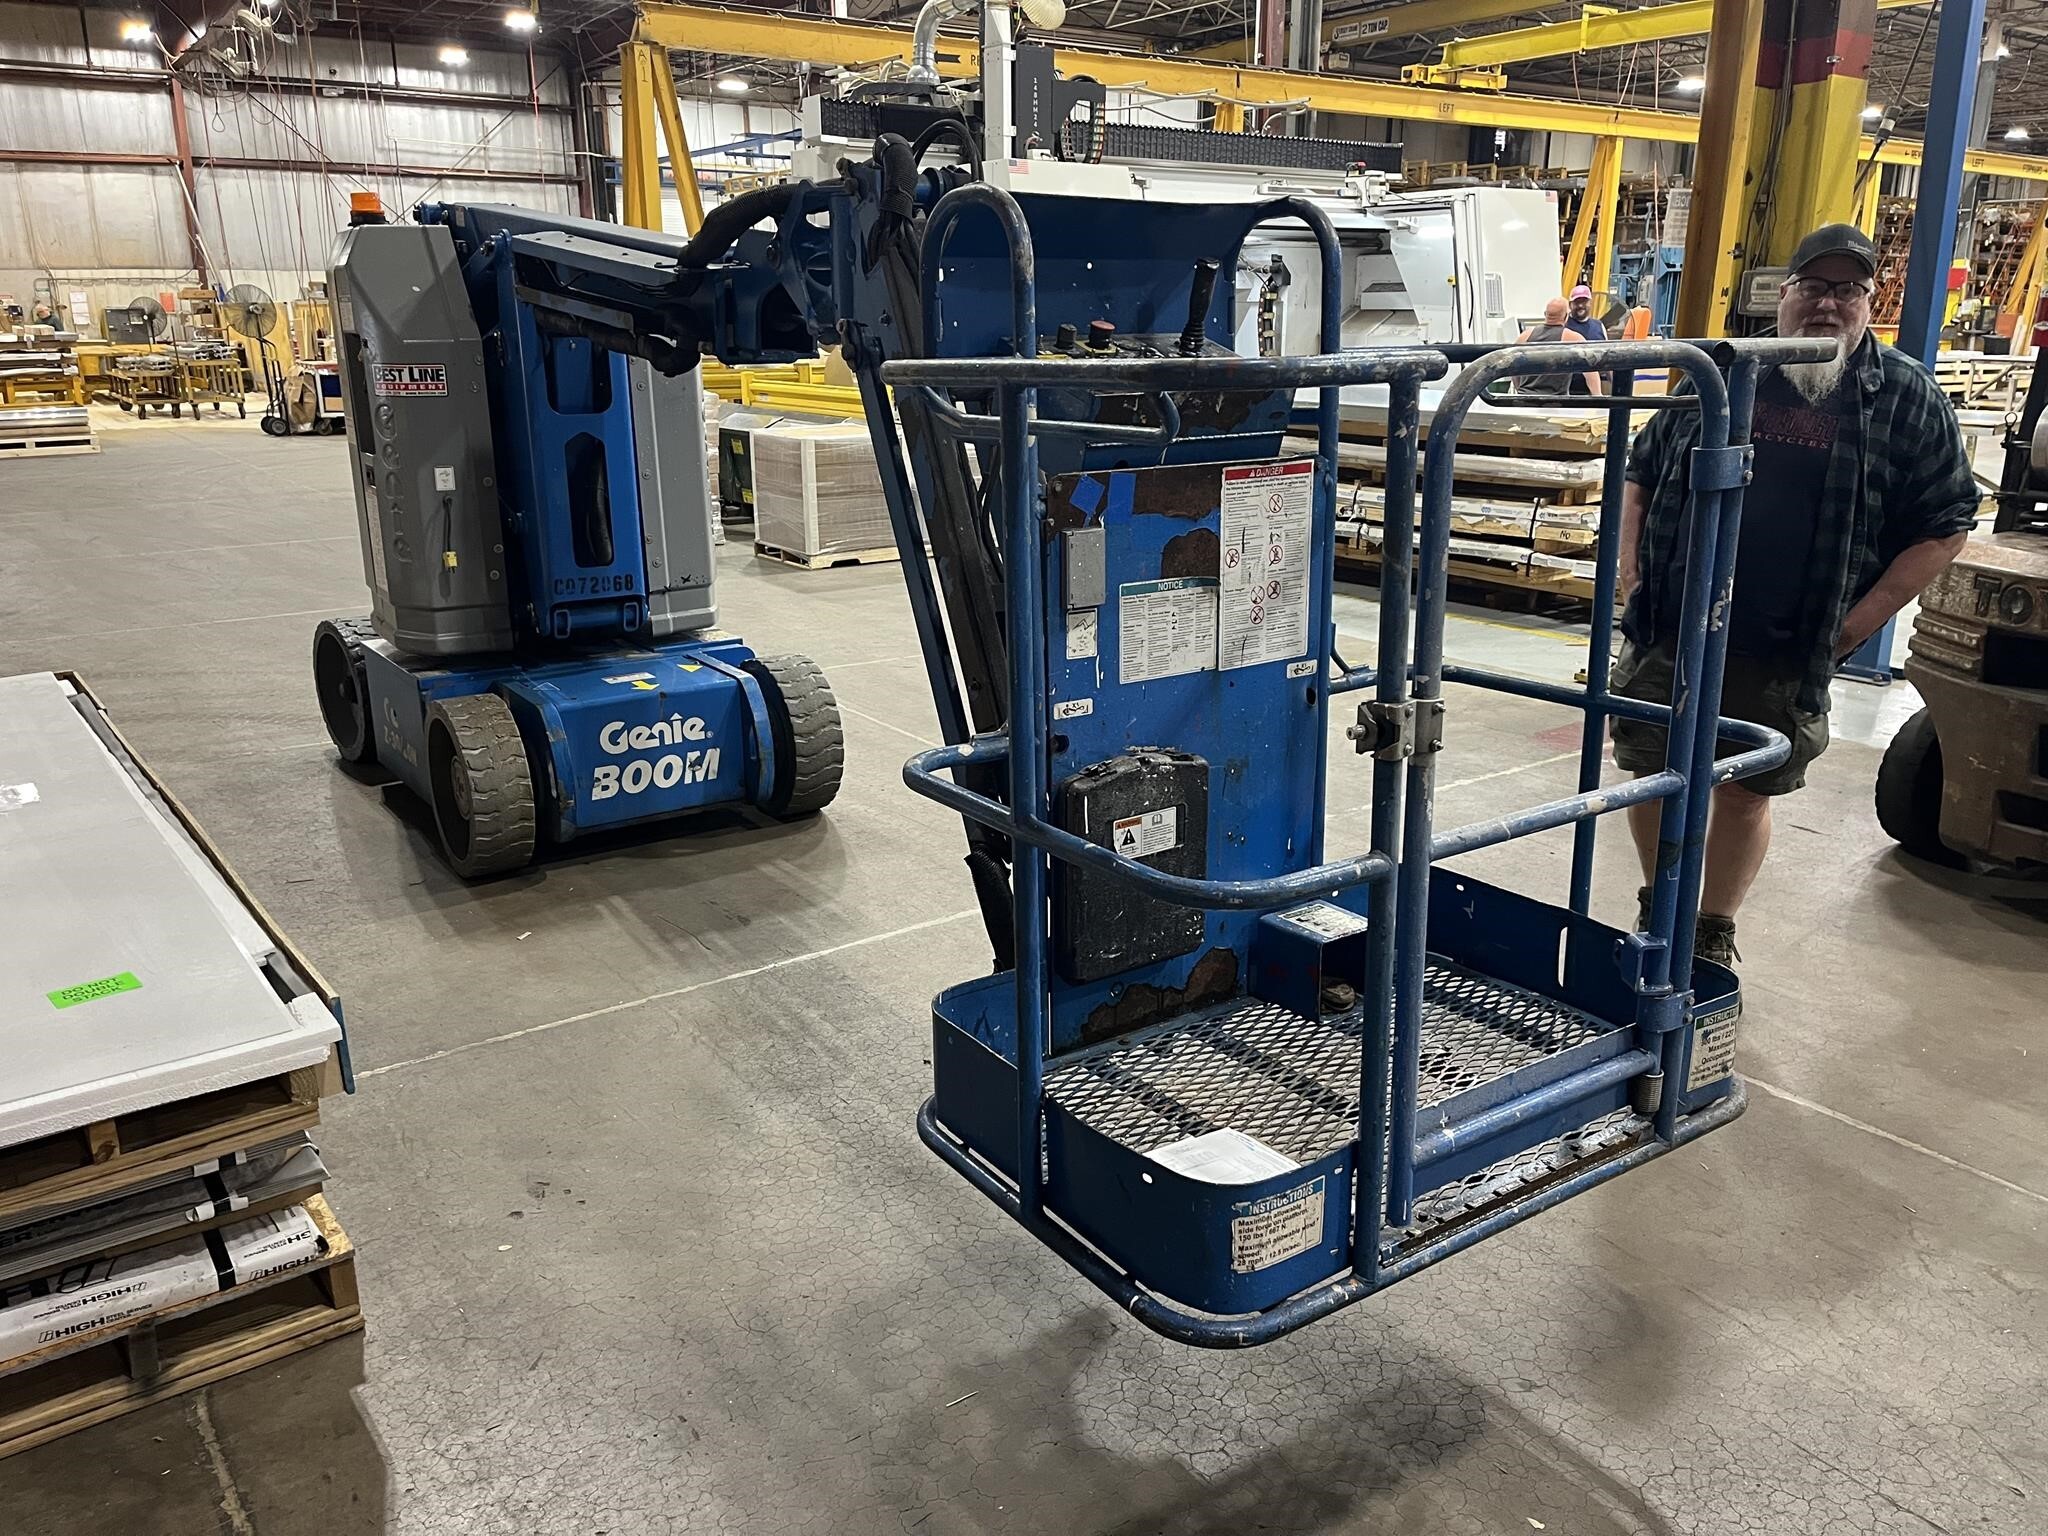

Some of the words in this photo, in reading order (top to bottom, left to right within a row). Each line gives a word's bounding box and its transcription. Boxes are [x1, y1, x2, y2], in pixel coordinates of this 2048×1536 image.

[1368, 22, 1378, 34] TON
[1378, 19, 1388, 31] CAP
[1439, 103, 1454, 113] LEFT
[1972, 158, 1984, 168] LEFT
[374, 366, 404, 382] BEST
[408, 366, 444, 382] LINE
[1256, 466, 1284, 477] DANGER
[1158, 580, 1184, 591] NOTICE
[600, 712, 706, 754] Genie
[592, 748, 720, 800] BOOM
[61, 986, 84, 995] DO
[88, 978, 116, 988] NOT
[62, 981, 123, 1000] DOUBLE
[72, 988, 122, 1002] STACK
[1249, 1184, 1314, 1216] INSTRUCTIONS
[1238, 1226, 1254, 1234] side
[1239, 1234, 1252, 1242] 150
[1268, 1226, 1280, 1234] 667
[1248, 1256, 1264, 1265] mph
[1270, 1250, 1282, 1258] 12.5
[81, 1285, 132, 1305] HIGH
[55, 1316, 105, 1338] HIGH
